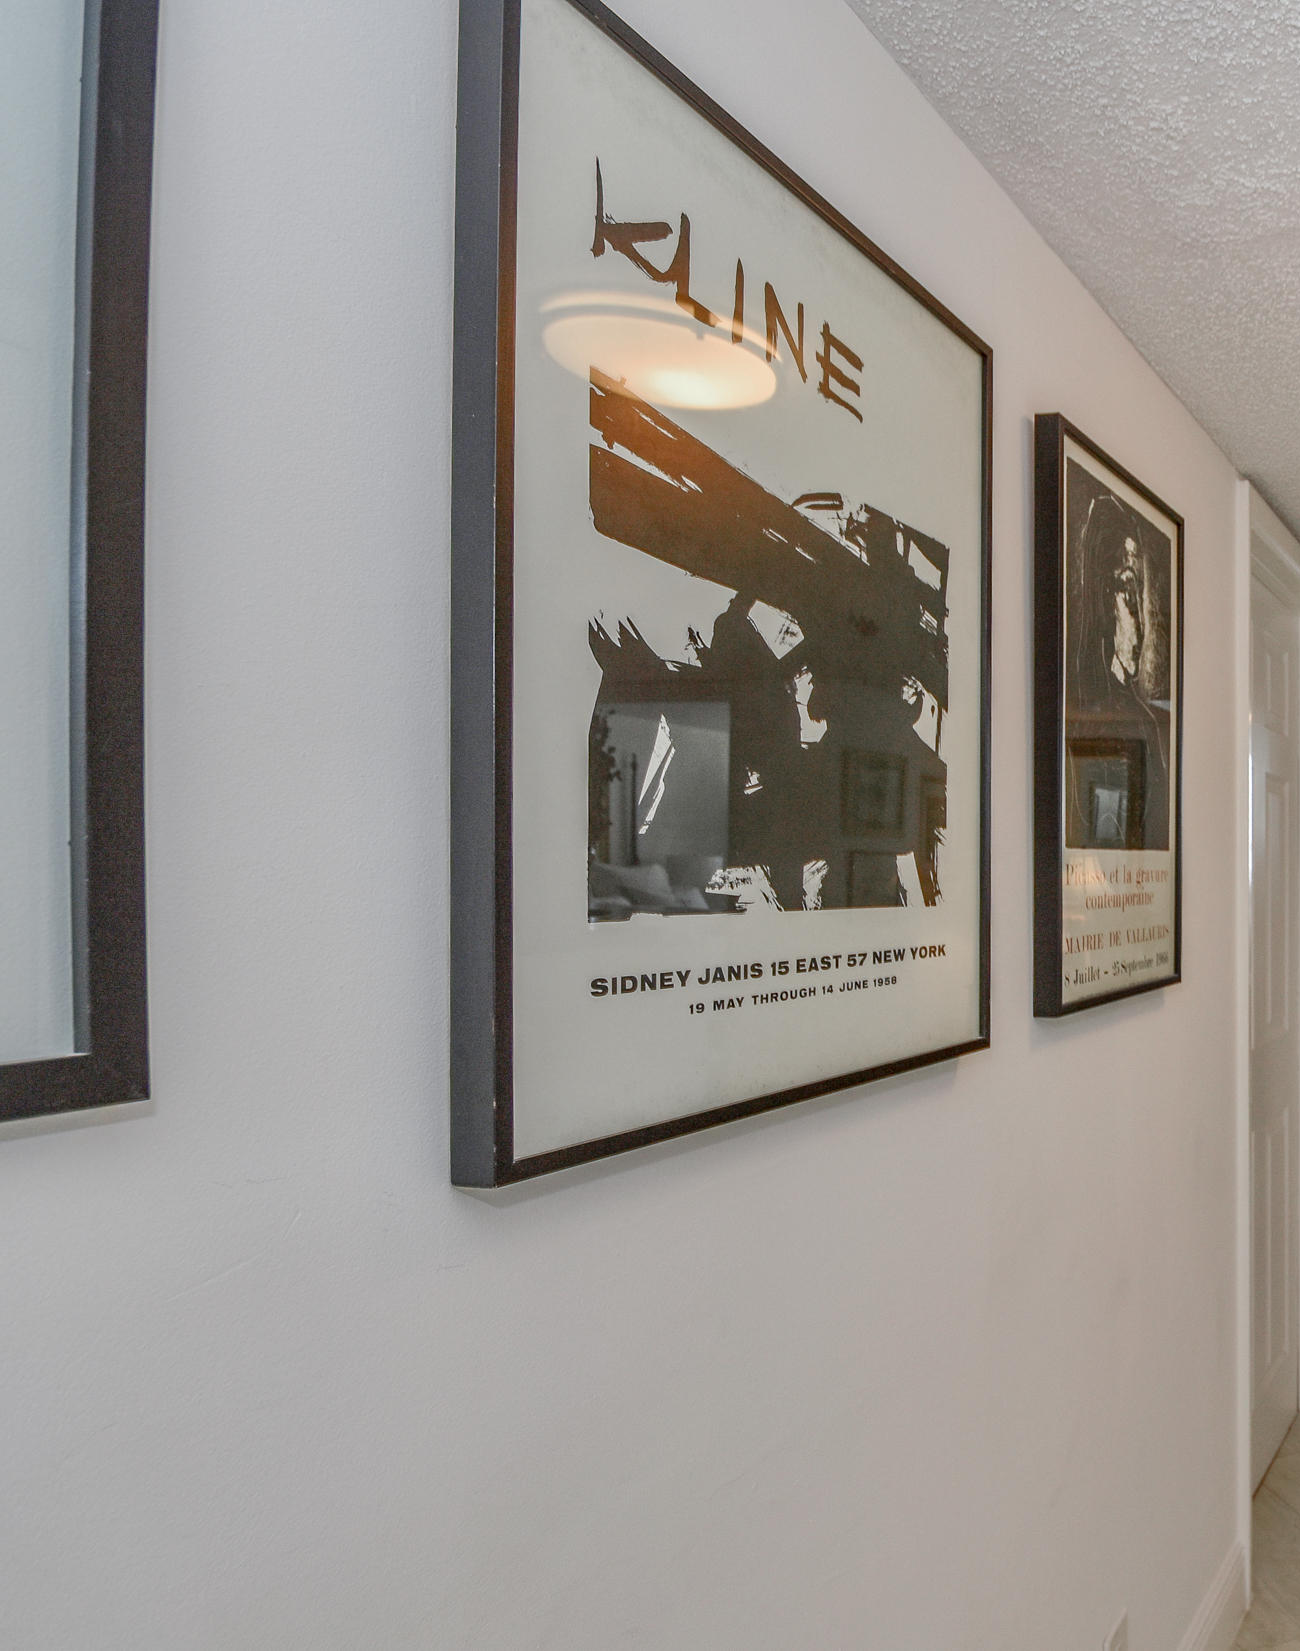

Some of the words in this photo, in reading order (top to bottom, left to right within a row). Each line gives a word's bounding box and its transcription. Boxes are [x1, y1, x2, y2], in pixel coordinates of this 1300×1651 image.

[590, 156, 864, 424] KLINE
[1109, 868, 1119, 884] et
[1123, 864, 1132, 884] la
[1136, 868, 1168, 888] gravure
[1065, 933, 1104, 955] MAIRIE
[1109, 930, 1122, 948] DE
[1126, 924, 1170, 945] VALLAURIS
[590, 970, 692, 998] SIDNEY
[697, 963, 763, 985] JANIS
[770, 960, 789, 977] 15
[796, 955, 842, 973] EAST
[847, 953, 867, 967] 57
[872, 948, 905, 965] NEW
[910, 944, 947, 959] YORK
[1073, 966, 1101, 985] Juillet
[689, 1002, 705, 1015] 19
[713, 995, 745, 1012] MAY
[751, 987, 816, 1005] THROUGH
[822, 984, 834, 996] 14
[839, 981, 869, 994] JUNE
